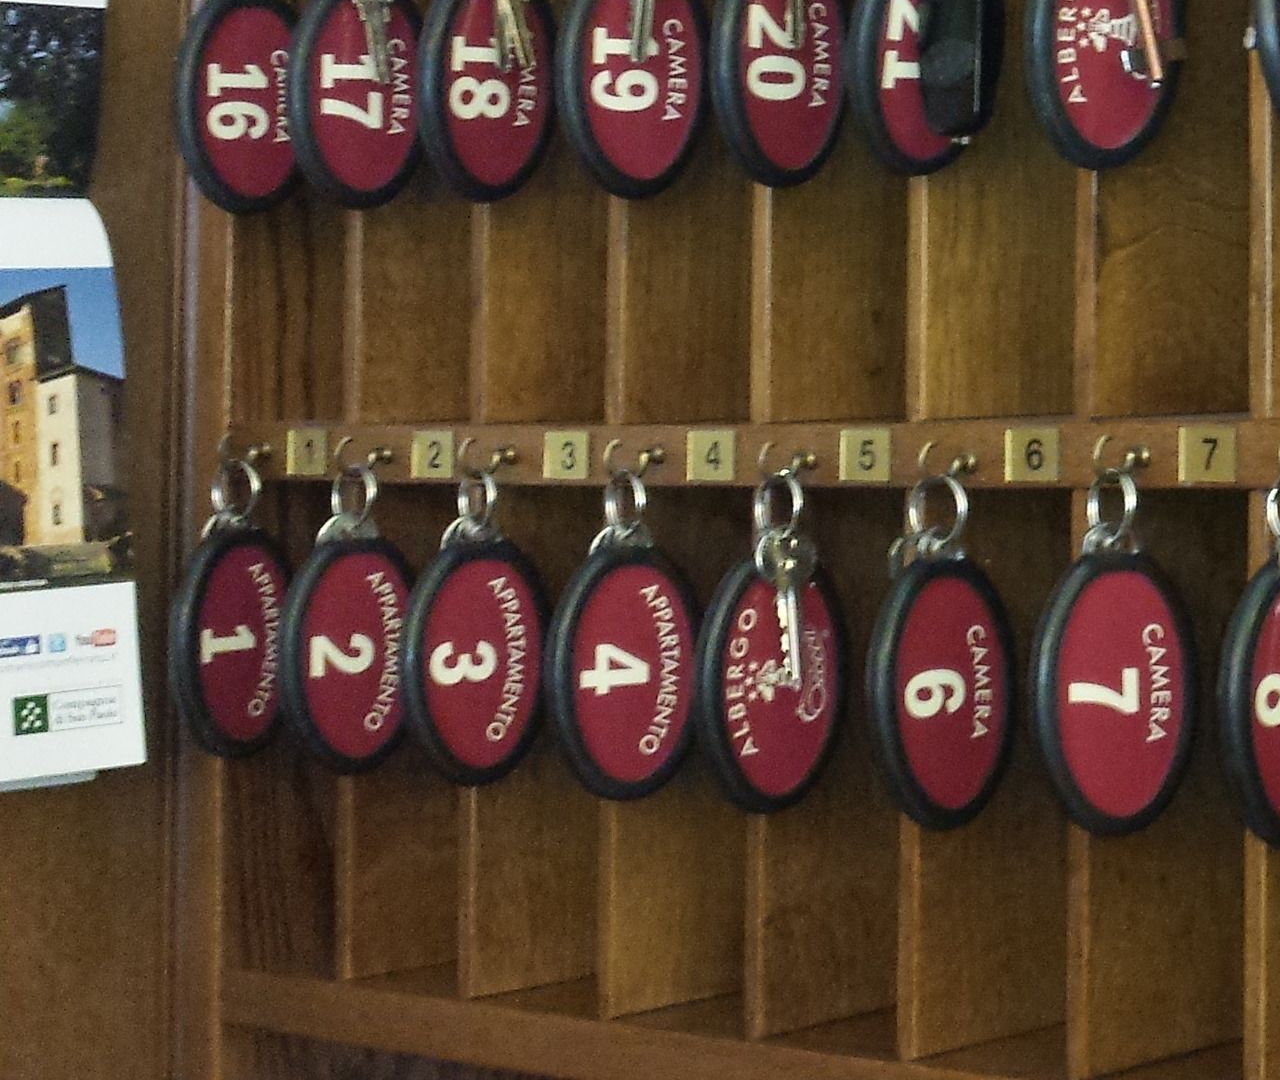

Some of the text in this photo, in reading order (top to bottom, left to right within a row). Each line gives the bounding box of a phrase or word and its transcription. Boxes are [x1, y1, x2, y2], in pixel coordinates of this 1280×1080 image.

[320, 53, 383, 129] 17
[386, 38, 413, 136] CAMERA
[450, 35, 511, 120] 18
[590, 26, 660, 112] 19
[661, 18, 689, 121] CAMERA
[807, 1, 832, 108] CAMERA
[207, 63, 270, 140] 16
[427, 440, 443, 469] 2
[560, 441, 576, 470] 3
[704, 440, 721, 471] 4
[856, 439, 876, 472] 5
[1025, 438, 1044, 472] 6
[1201, 438, 1219, 470] 7
[201, 624, 256, 664] 1
[248, 563, 281, 717] APPARTAMENTO
[309, 633, 375, 678] 2
[363, 571, 402, 732] APPARTAMENTO
[429, 640, 498, 686] 3
[486, 576, 526, 742] APPARTAMENTO
[579, 643, 650, 695] 4
[638, 584, 681, 755] APPARTAMENTO
[726, 608, 760, 757] ALBERGO
[904, 668, 967, 719] 6
[966, 624, 993, 739] CAMERA
[1067, 667, 1140, 716] 7
[1142, 623, 1172, 743] CAMERA
